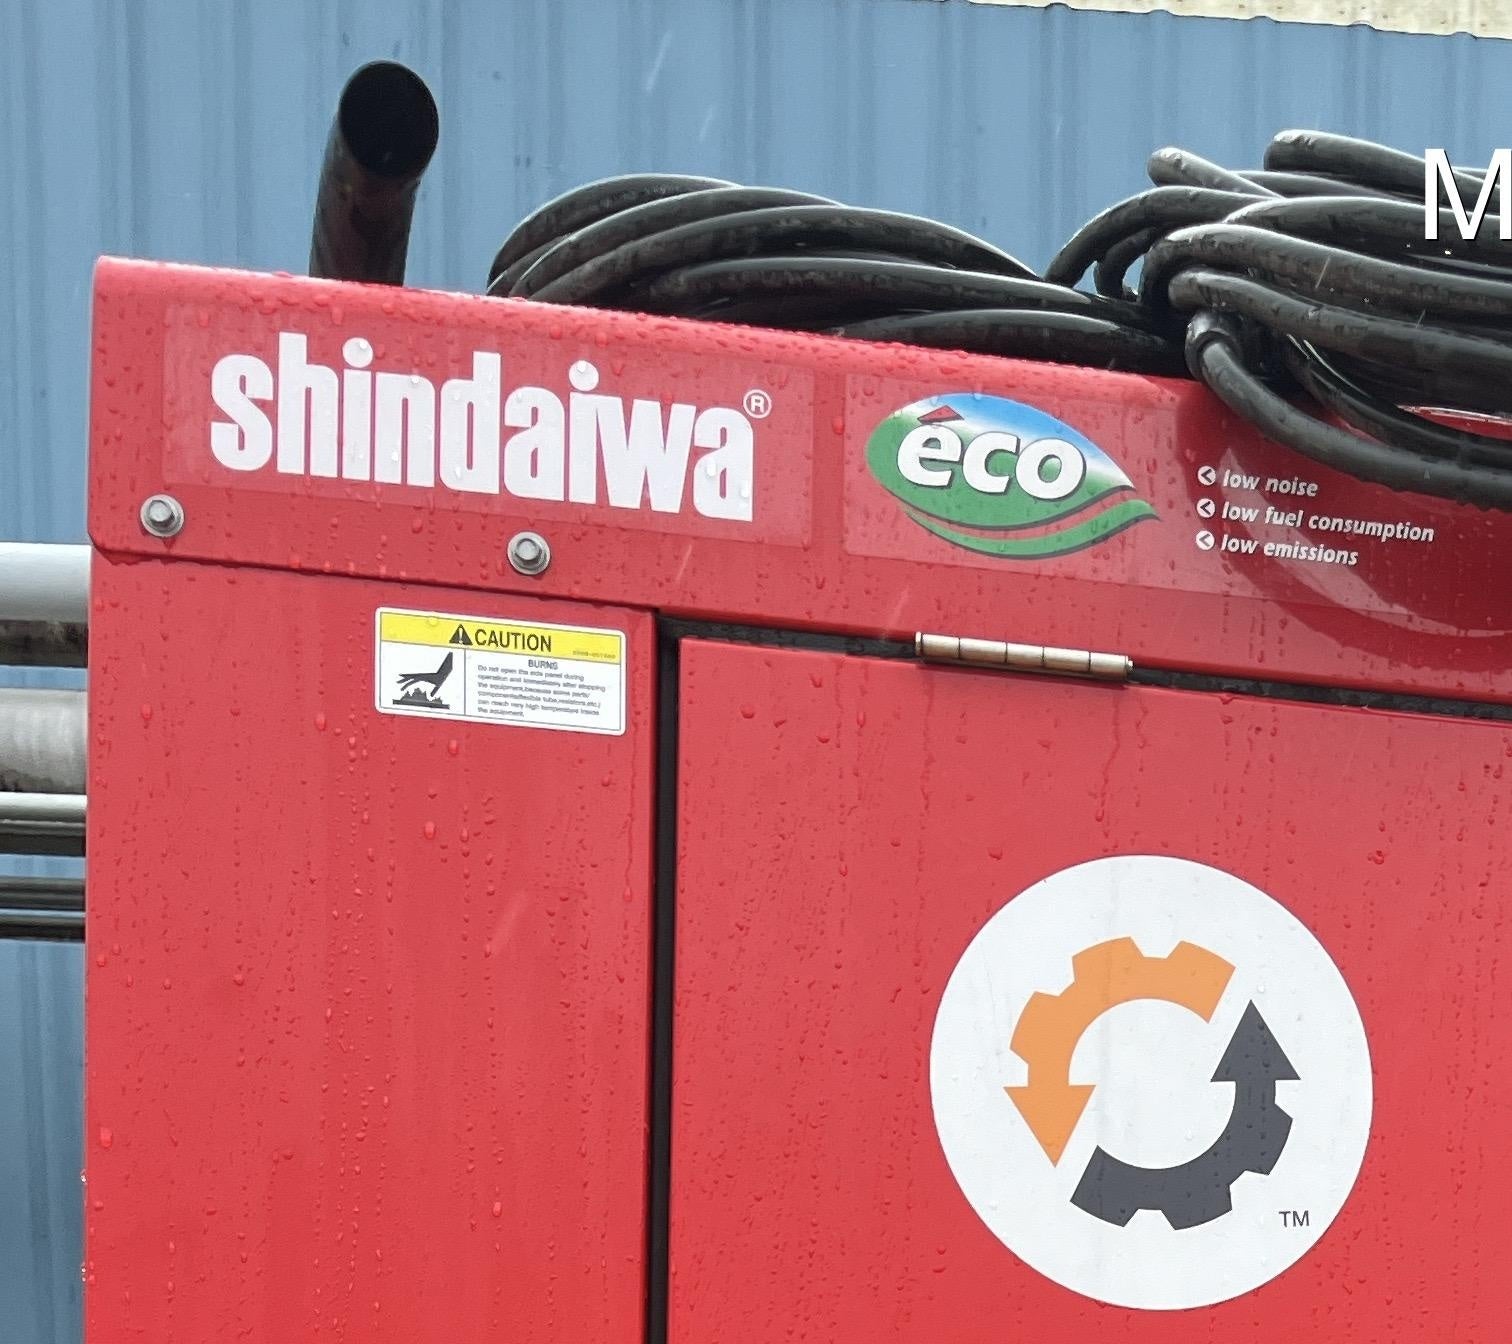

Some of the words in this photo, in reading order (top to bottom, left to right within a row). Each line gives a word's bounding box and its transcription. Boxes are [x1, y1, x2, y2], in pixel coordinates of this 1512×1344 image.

[1222, 468, 1260, 491] low
[1265, 475, 1318, 498] noise
[1221, 501, 1259, 524] low
[1263, 505, 1304, 529] fuel
[1308, 514, 1435, 543] consumption
[1220, 533, 1258, 556] low
[1262, 539, 1359, 567] emissions
[475, 628, 552, 652] CAUTION
[1278, 1210, 1310, 1228] TM
